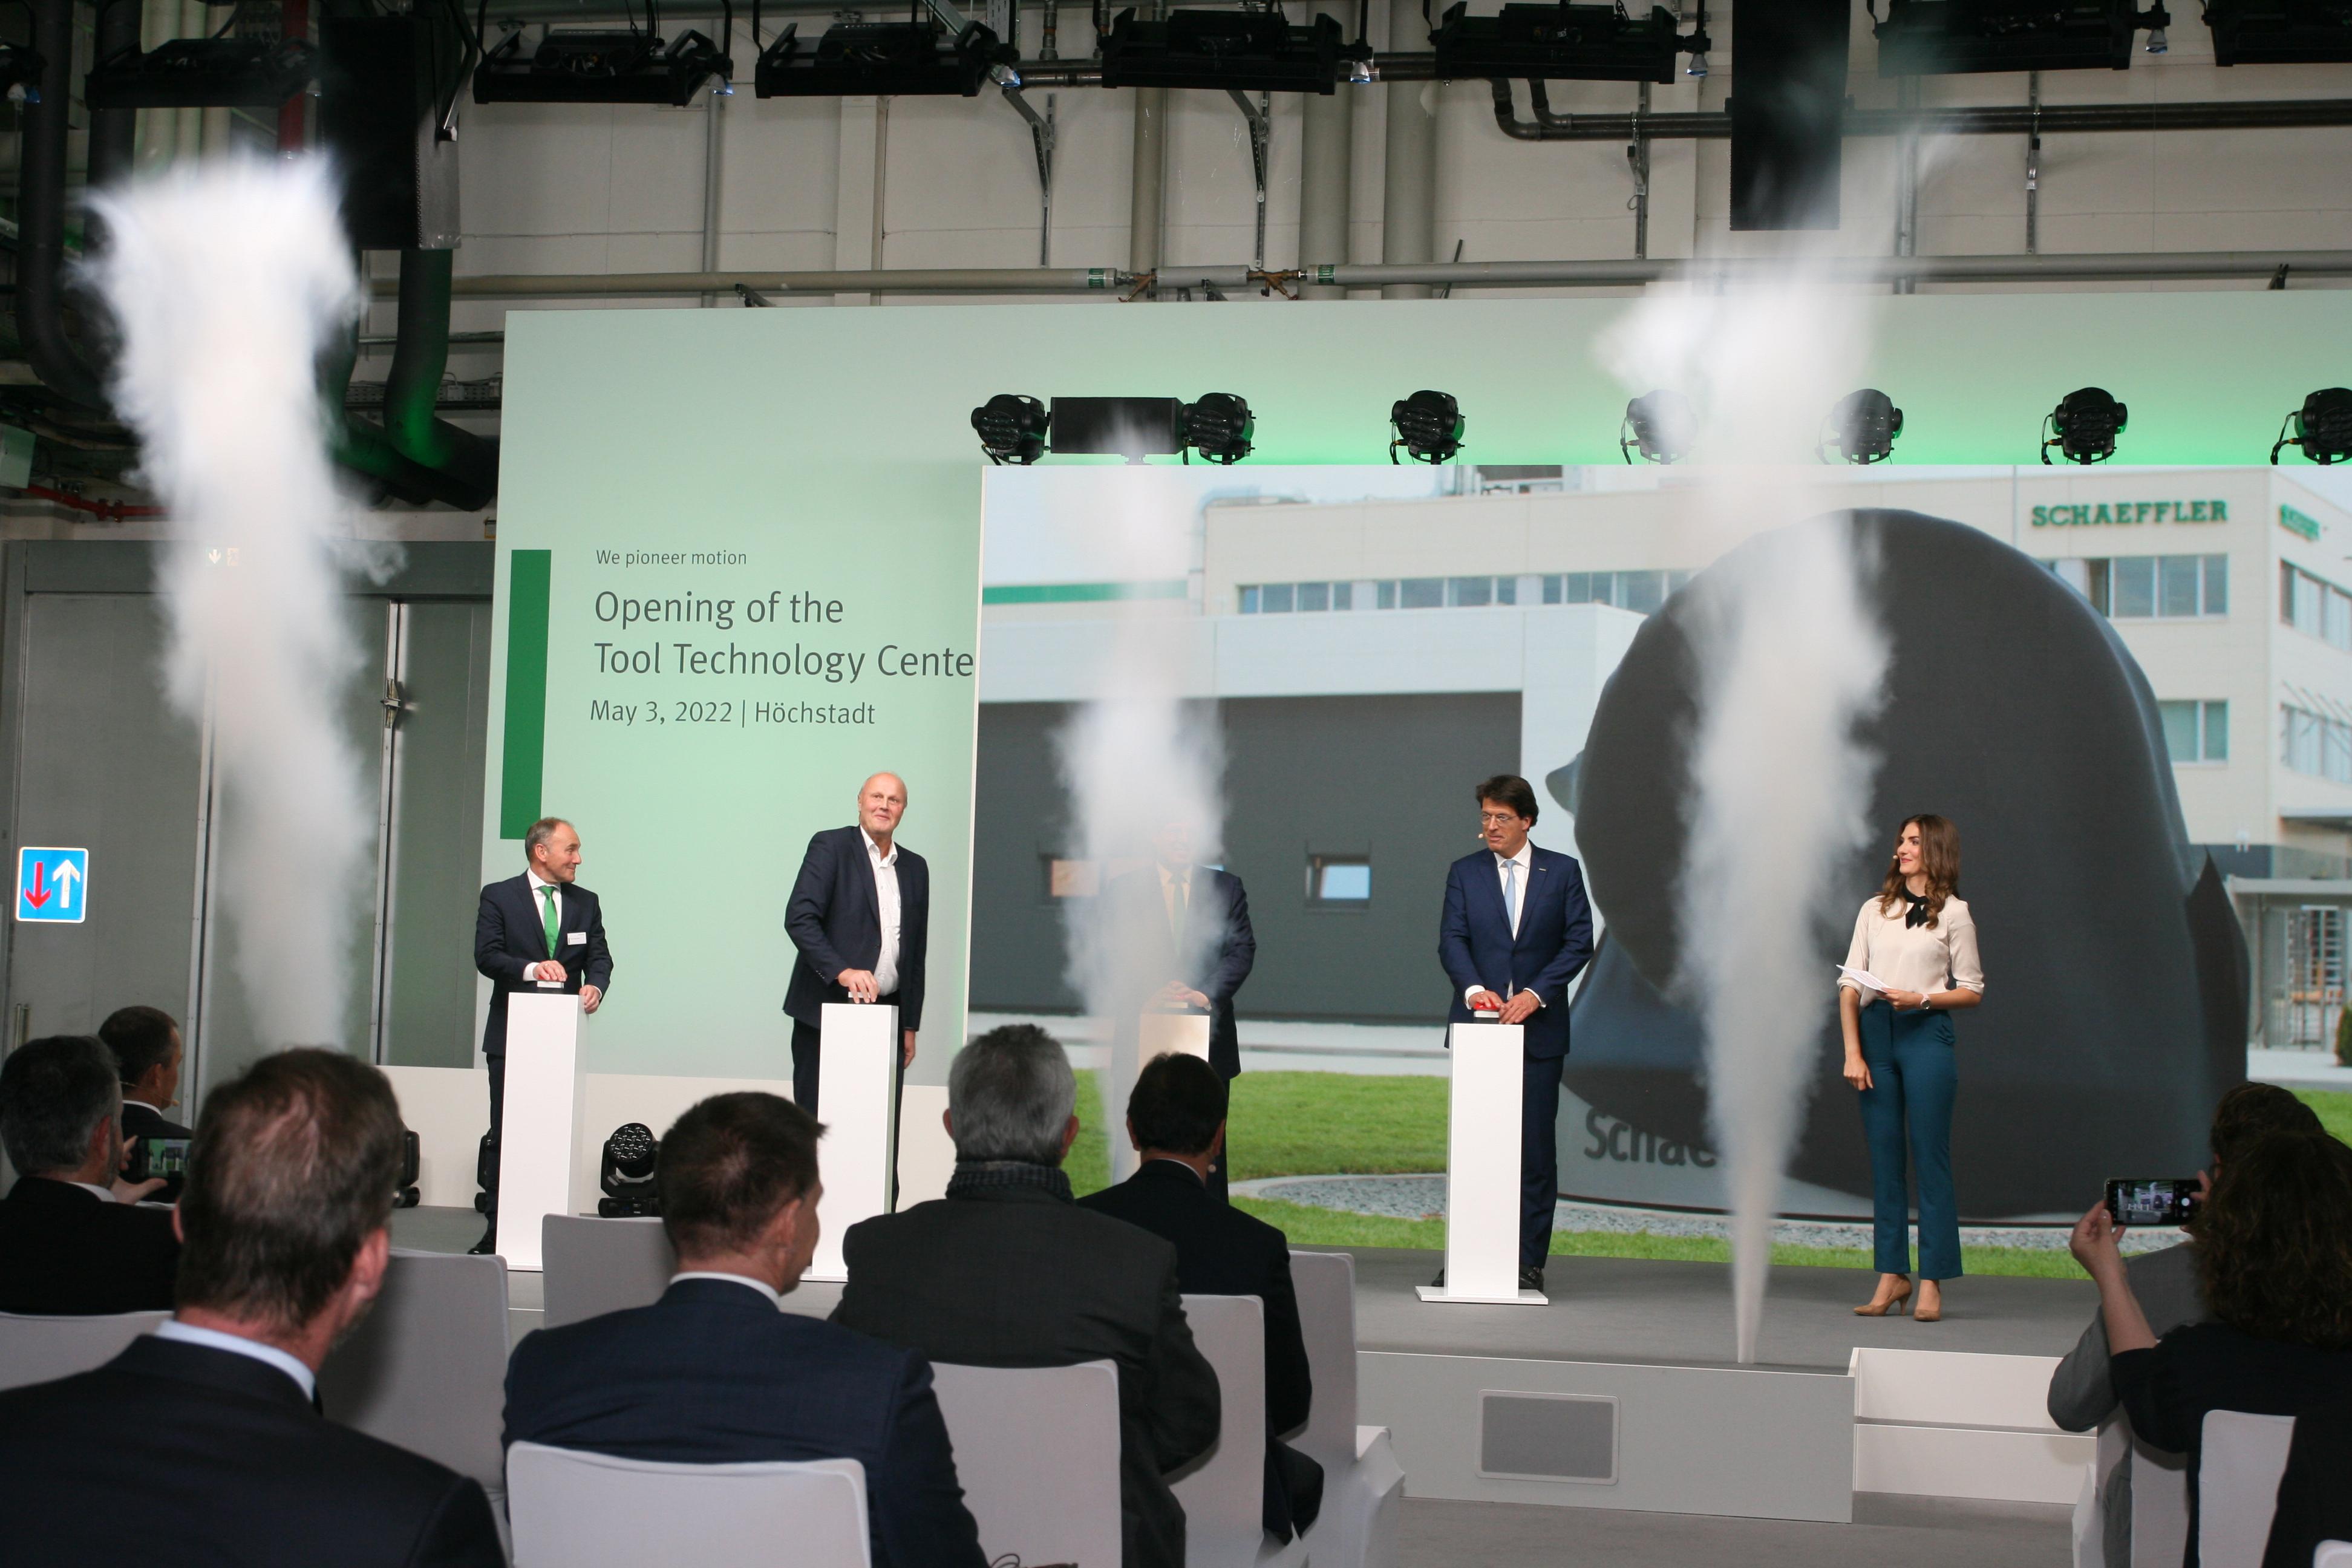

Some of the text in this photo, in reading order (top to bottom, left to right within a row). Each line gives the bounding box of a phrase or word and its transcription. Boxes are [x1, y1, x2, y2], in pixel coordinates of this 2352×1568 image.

[2031, 500, 2228, 526] SCHAEFFLER
[596, 549, 746, 569] We pioneer motion
[595, 590, 844, 630] Opening of the
[594, 641, 974, 684] Tool Technology Cente
[590, 699, 638, 727] May
[645, 701, 665, 725] 3,
[675, 701, 732, 722] 2022
[756, 700, 876, 725] Höchstadt
